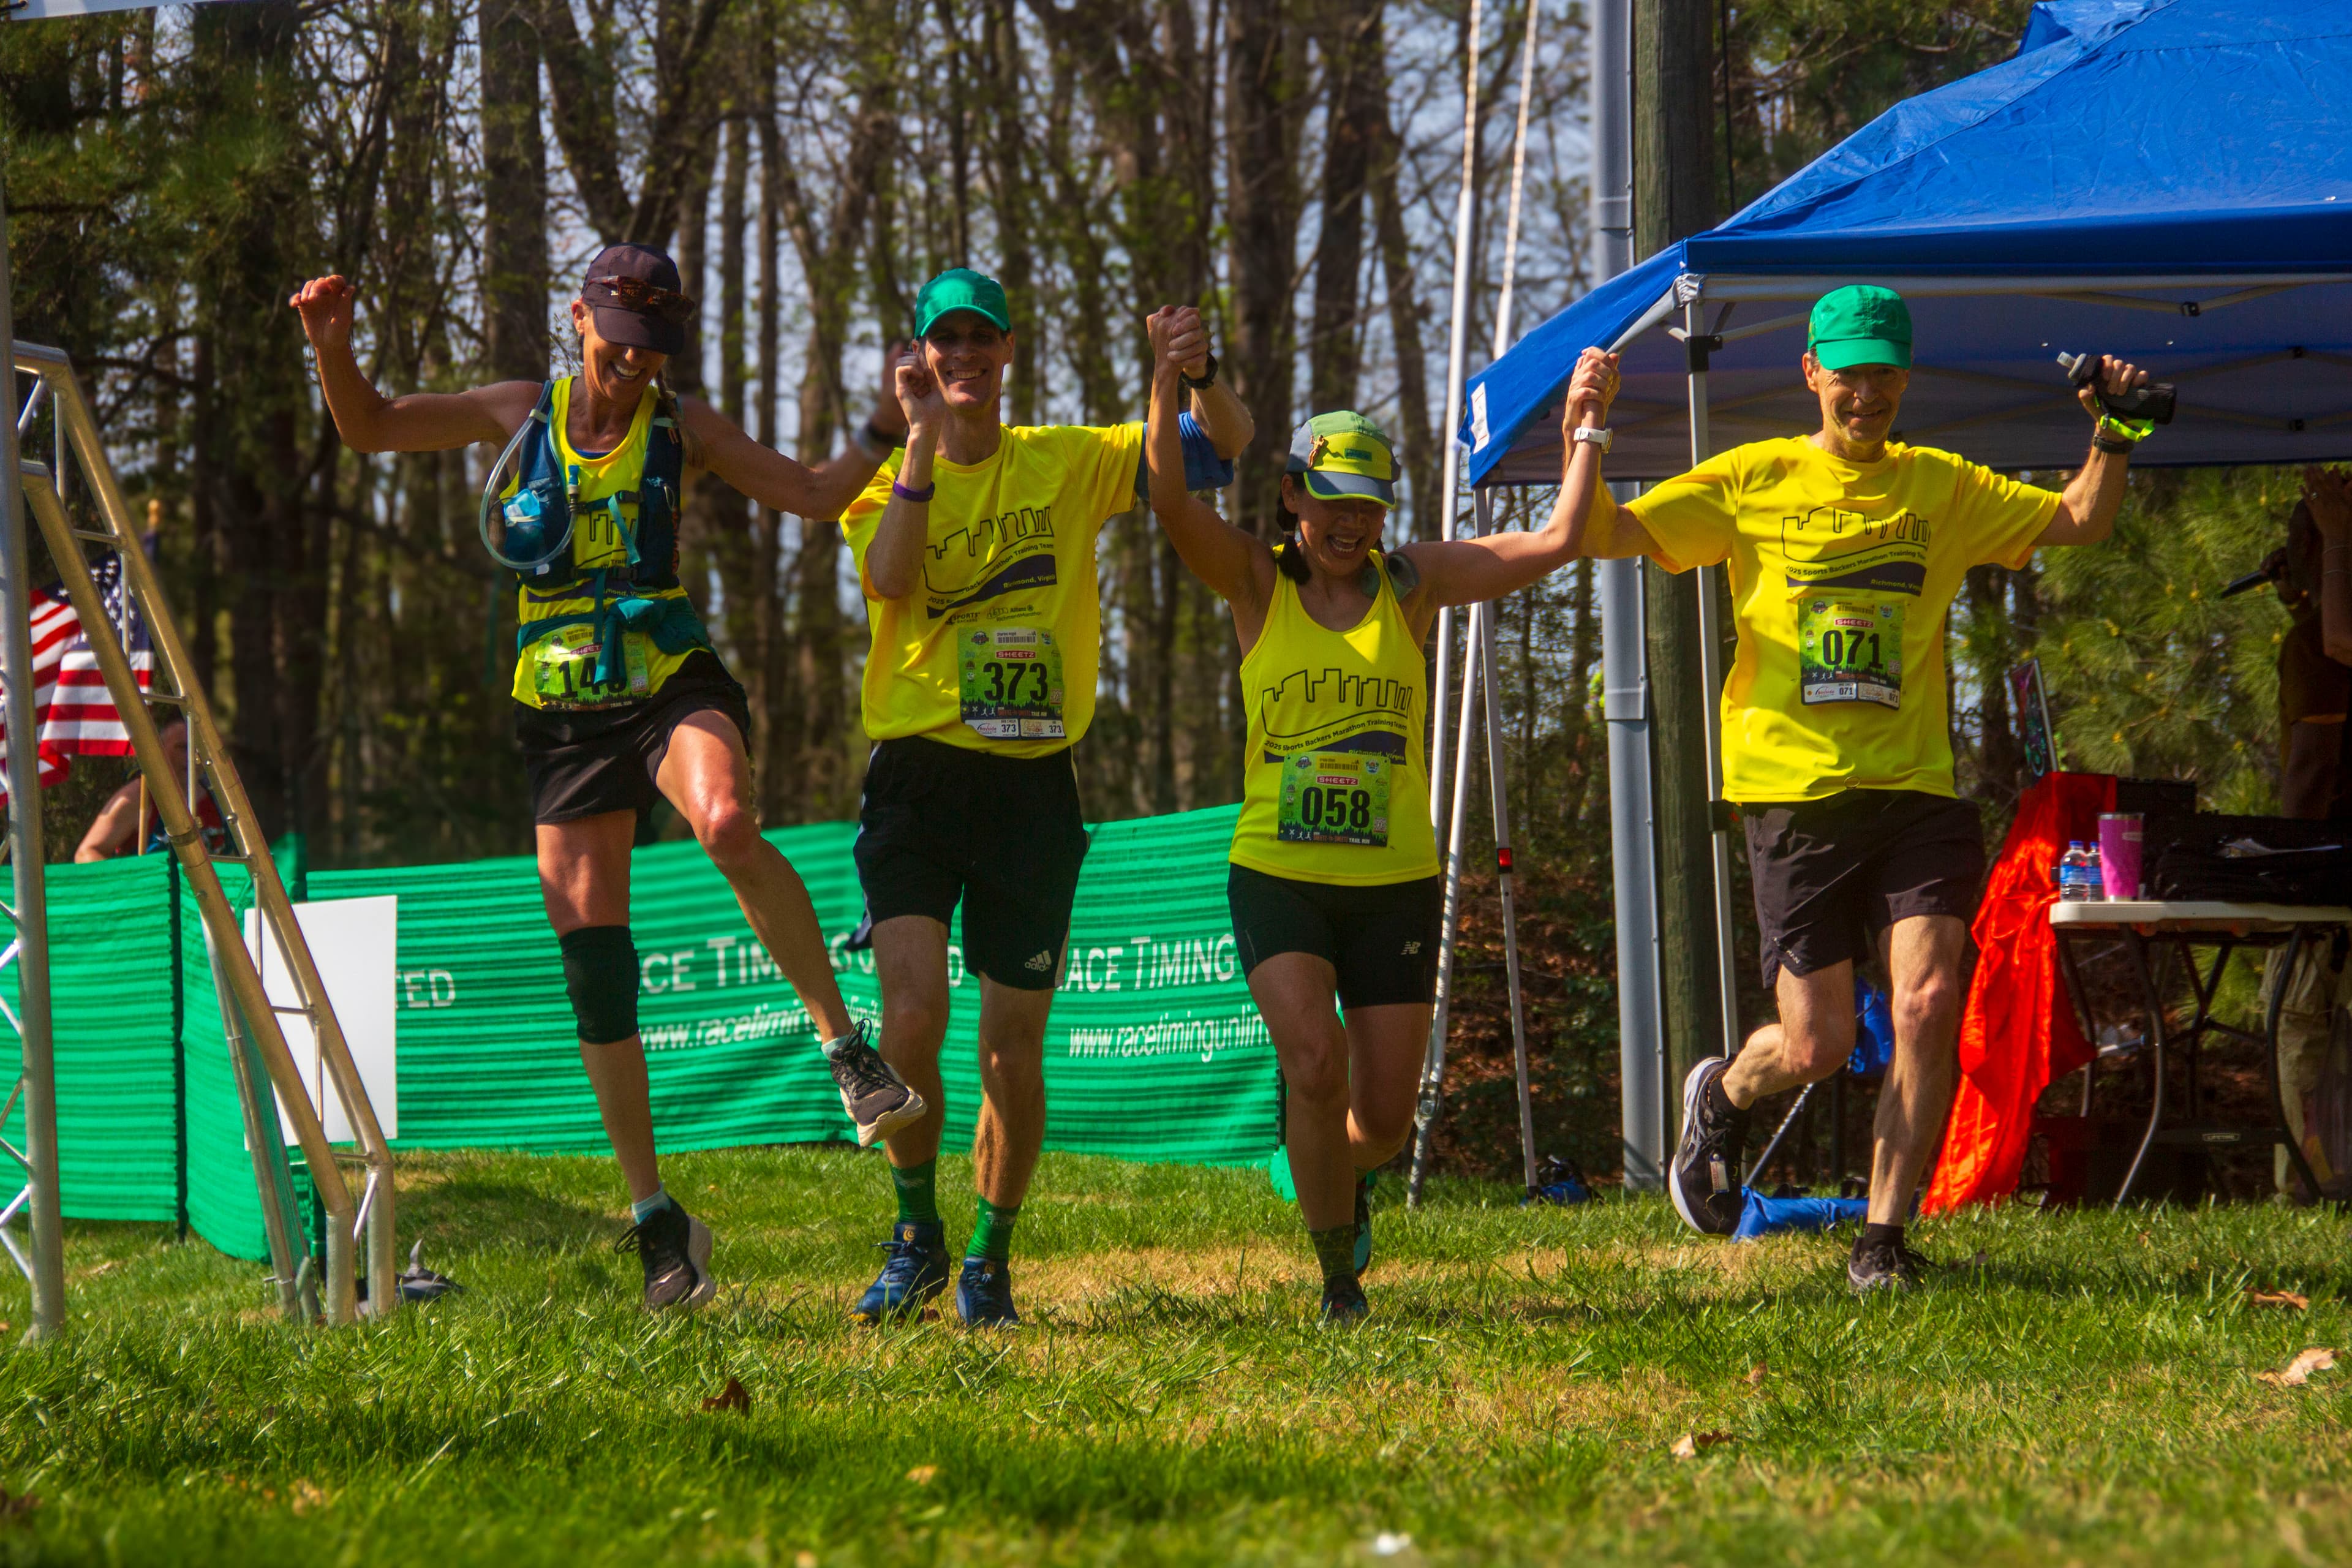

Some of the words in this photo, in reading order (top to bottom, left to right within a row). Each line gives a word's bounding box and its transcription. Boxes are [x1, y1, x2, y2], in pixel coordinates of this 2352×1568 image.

[927, 596, 944, 605] 2025
[1014, 545, 1039, 556] Training
[1785, 565, 1801, 575] 2025
[1829, 562, 1856, 573] Backers
[1856, 553, 1888, 565] Marathon
[1837, 619, 1874, 627] SHEETZ
[572, 644, 603, 655] SHEET
[1822, 630, 1883, 669] 071
[983, 662, 1049, 701] 373
[1839, 687, 1853, 696] 071
[1888, 692, 1898, 703] 071
[1001, 723, 1017, 733] 373
[1049, 725, 1062, 734] 373
[1264, 740, 1281, 750] 2025
[1305, 734, 1332, 746] Backers
[1332, 722, 1366, 737] Marathon
[1366, 718, 1394, 729] Training
[1394, 721, 1408, 731] Team
[1319, 777, 1357, 785] SHEETZ
[1301, 786, 1371, 829] 058
[641, 949, 697, 994] CE
[1056, 946, 1123, 993] ACE
